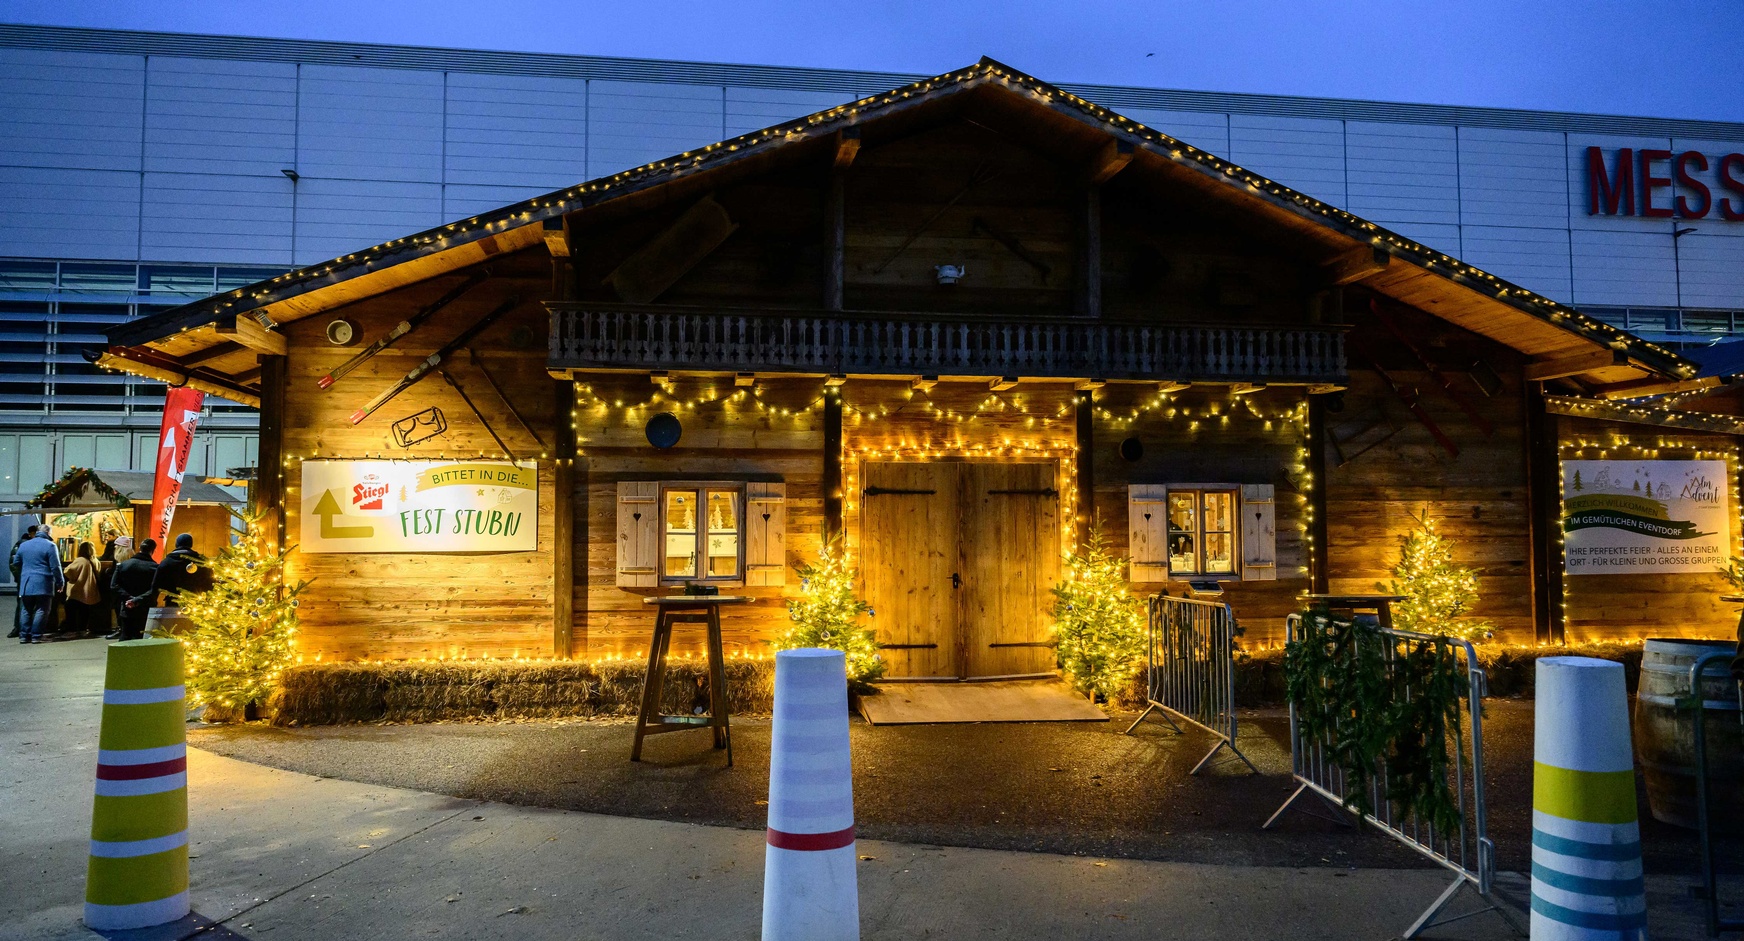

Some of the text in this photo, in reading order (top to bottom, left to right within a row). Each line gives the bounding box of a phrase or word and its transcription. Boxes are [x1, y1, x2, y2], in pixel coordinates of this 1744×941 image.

[1587, 146, 1744, 222] MESS
[158, 417, 196, 539] WIRTSCHAFTSKAMMER
[432, 469, 529, 486] BITTET IN DIE...
[1689, 475, 1713, 492] Alm
[352, 483, 389, 505] Stiegl
[1680, 484, 1720, 504] Advent
[1566, 499, 1659, 517] HERZLICH WILLKOMMEN
[399, 508, 522, 538] FEST STUBN
[1570, 514, 1682, 536] IM GEMÜTLICHEN EVENTDORF
[1569, 547, 1588, 556] IHRE
[1589, 547, 1628, 555] PERFEKTE
[1629, 546, 1651, 555] FEIER
[1656, 546, 1680, 554] ALLES
[1681, 546, 1693, 554] AN
[1694, 545, 1719, 554] EINEM
[1569, 558, 1586, 567] ORT
[1592, 556, 1608, 566] FÜR
[1609, 558, 1637, 566] KLEINE
[1638, 557, 1657, 565] UND
[1658, 556, 1690, 565] GROSSE
[1691, 555, 1727, 564] GRUPPEN
